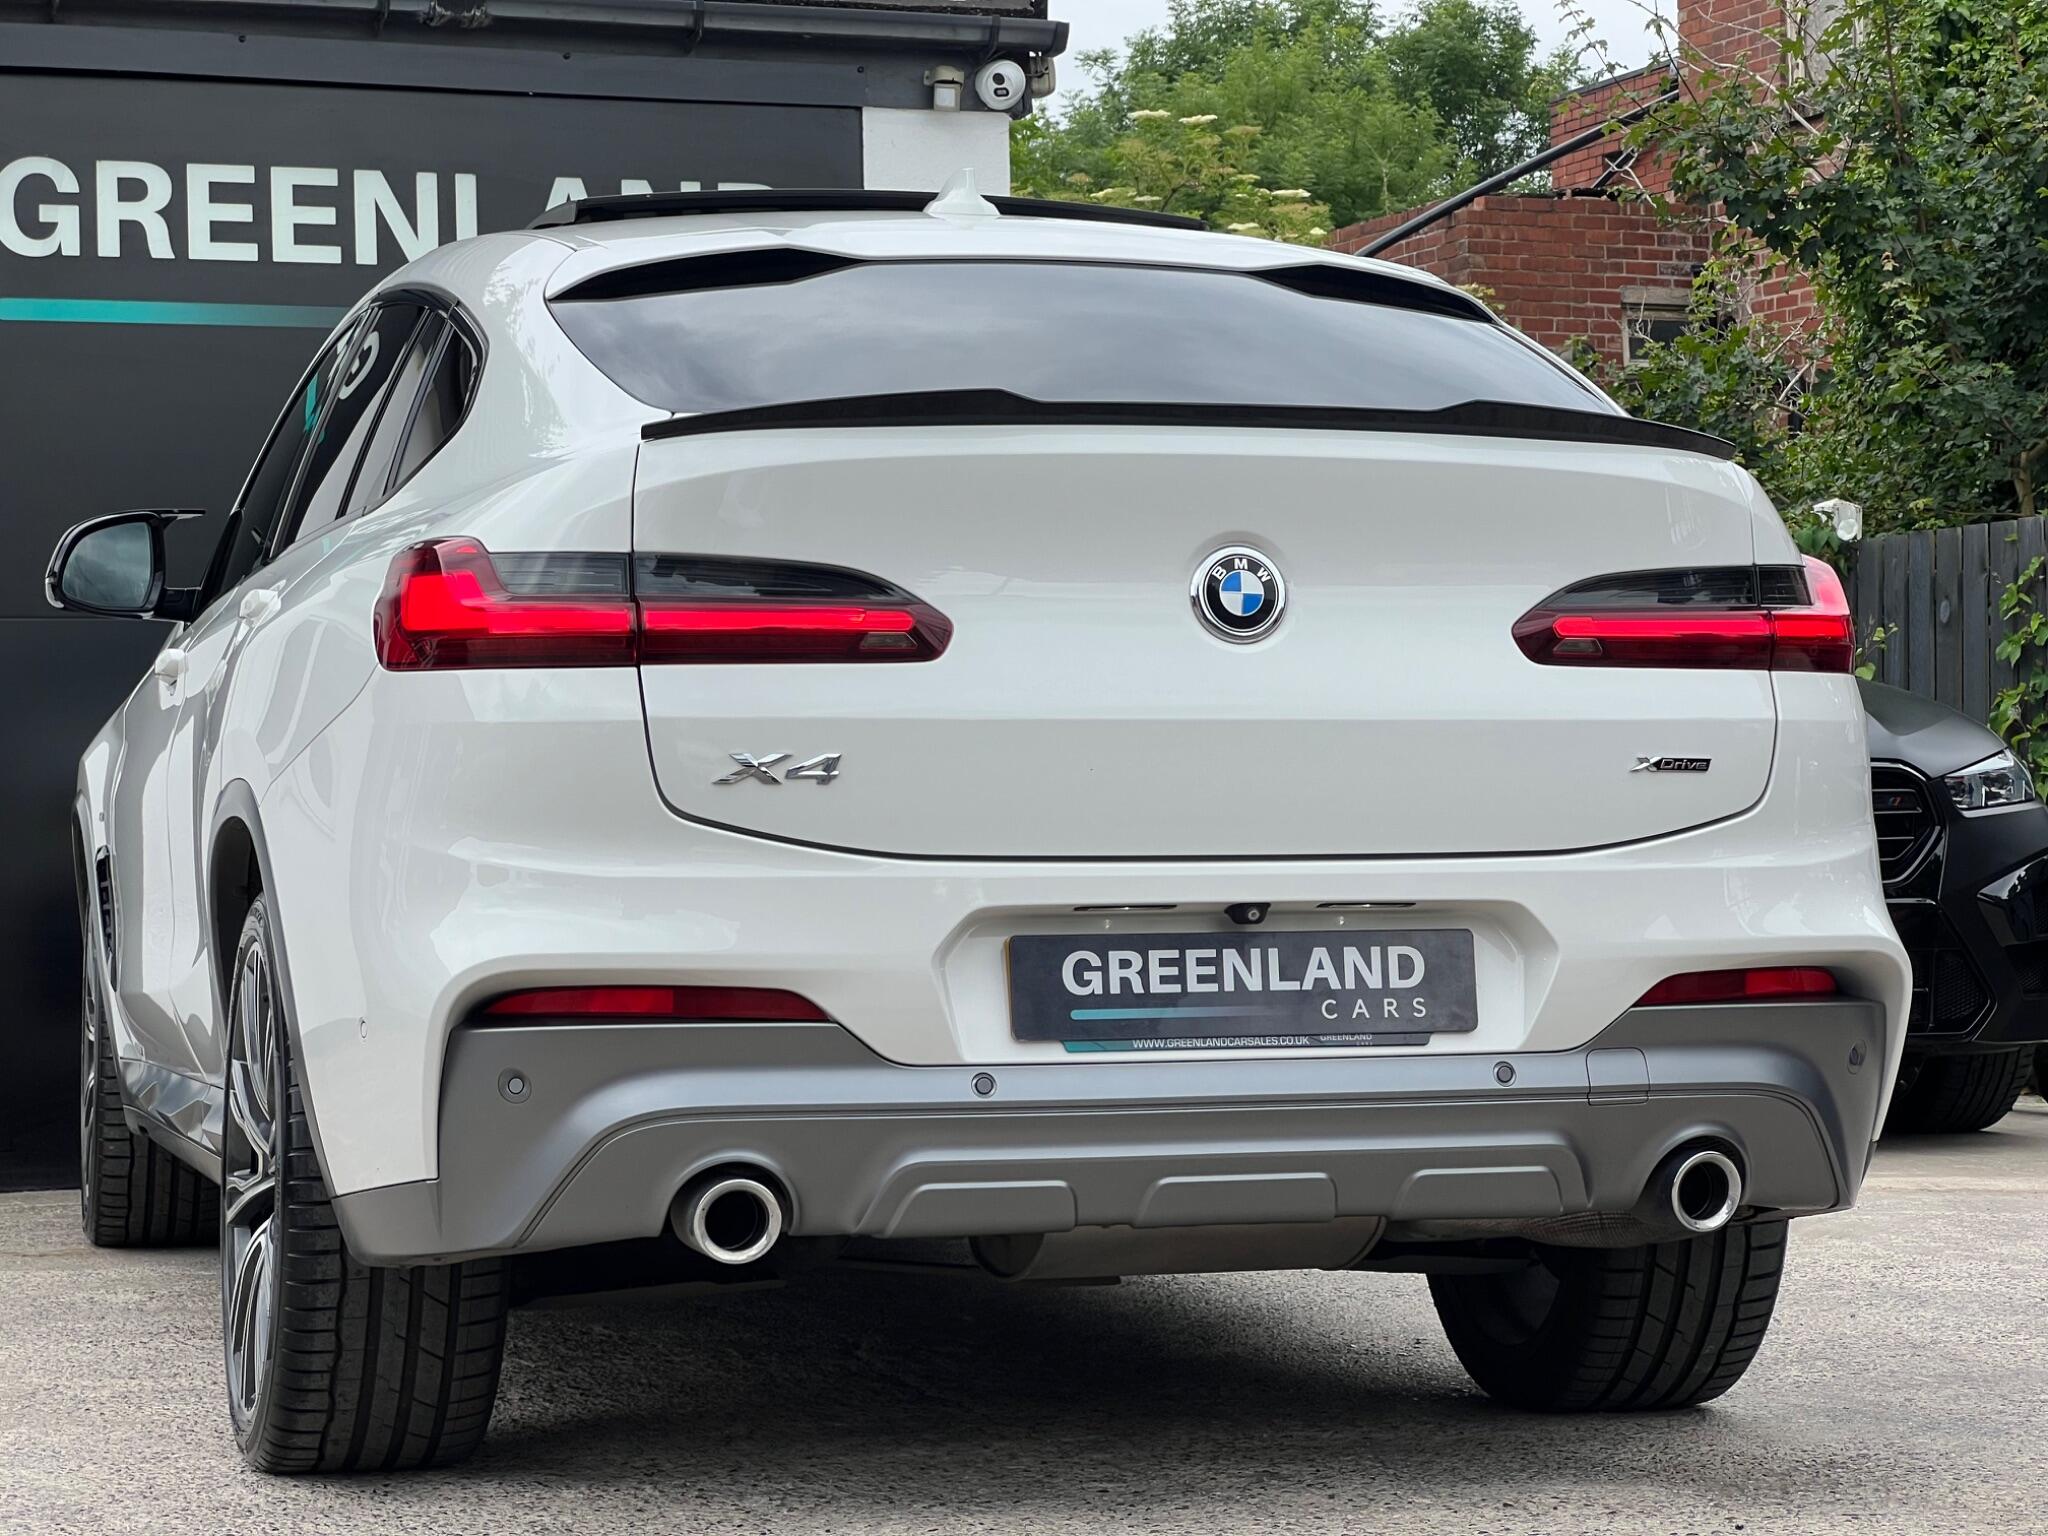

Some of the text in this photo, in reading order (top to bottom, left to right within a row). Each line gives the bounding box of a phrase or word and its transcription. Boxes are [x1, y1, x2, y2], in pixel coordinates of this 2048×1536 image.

[1211, 558, 1272, 583] BMW
[711, 753, 843, 786] X4
[1062, 946, 1425, 995] GREENLAND
[1321, 998, 1426, 1019] CARS
[1132, 1036, 1310, 1049] WWW.GREENLANDCARSALES.CO.UK
